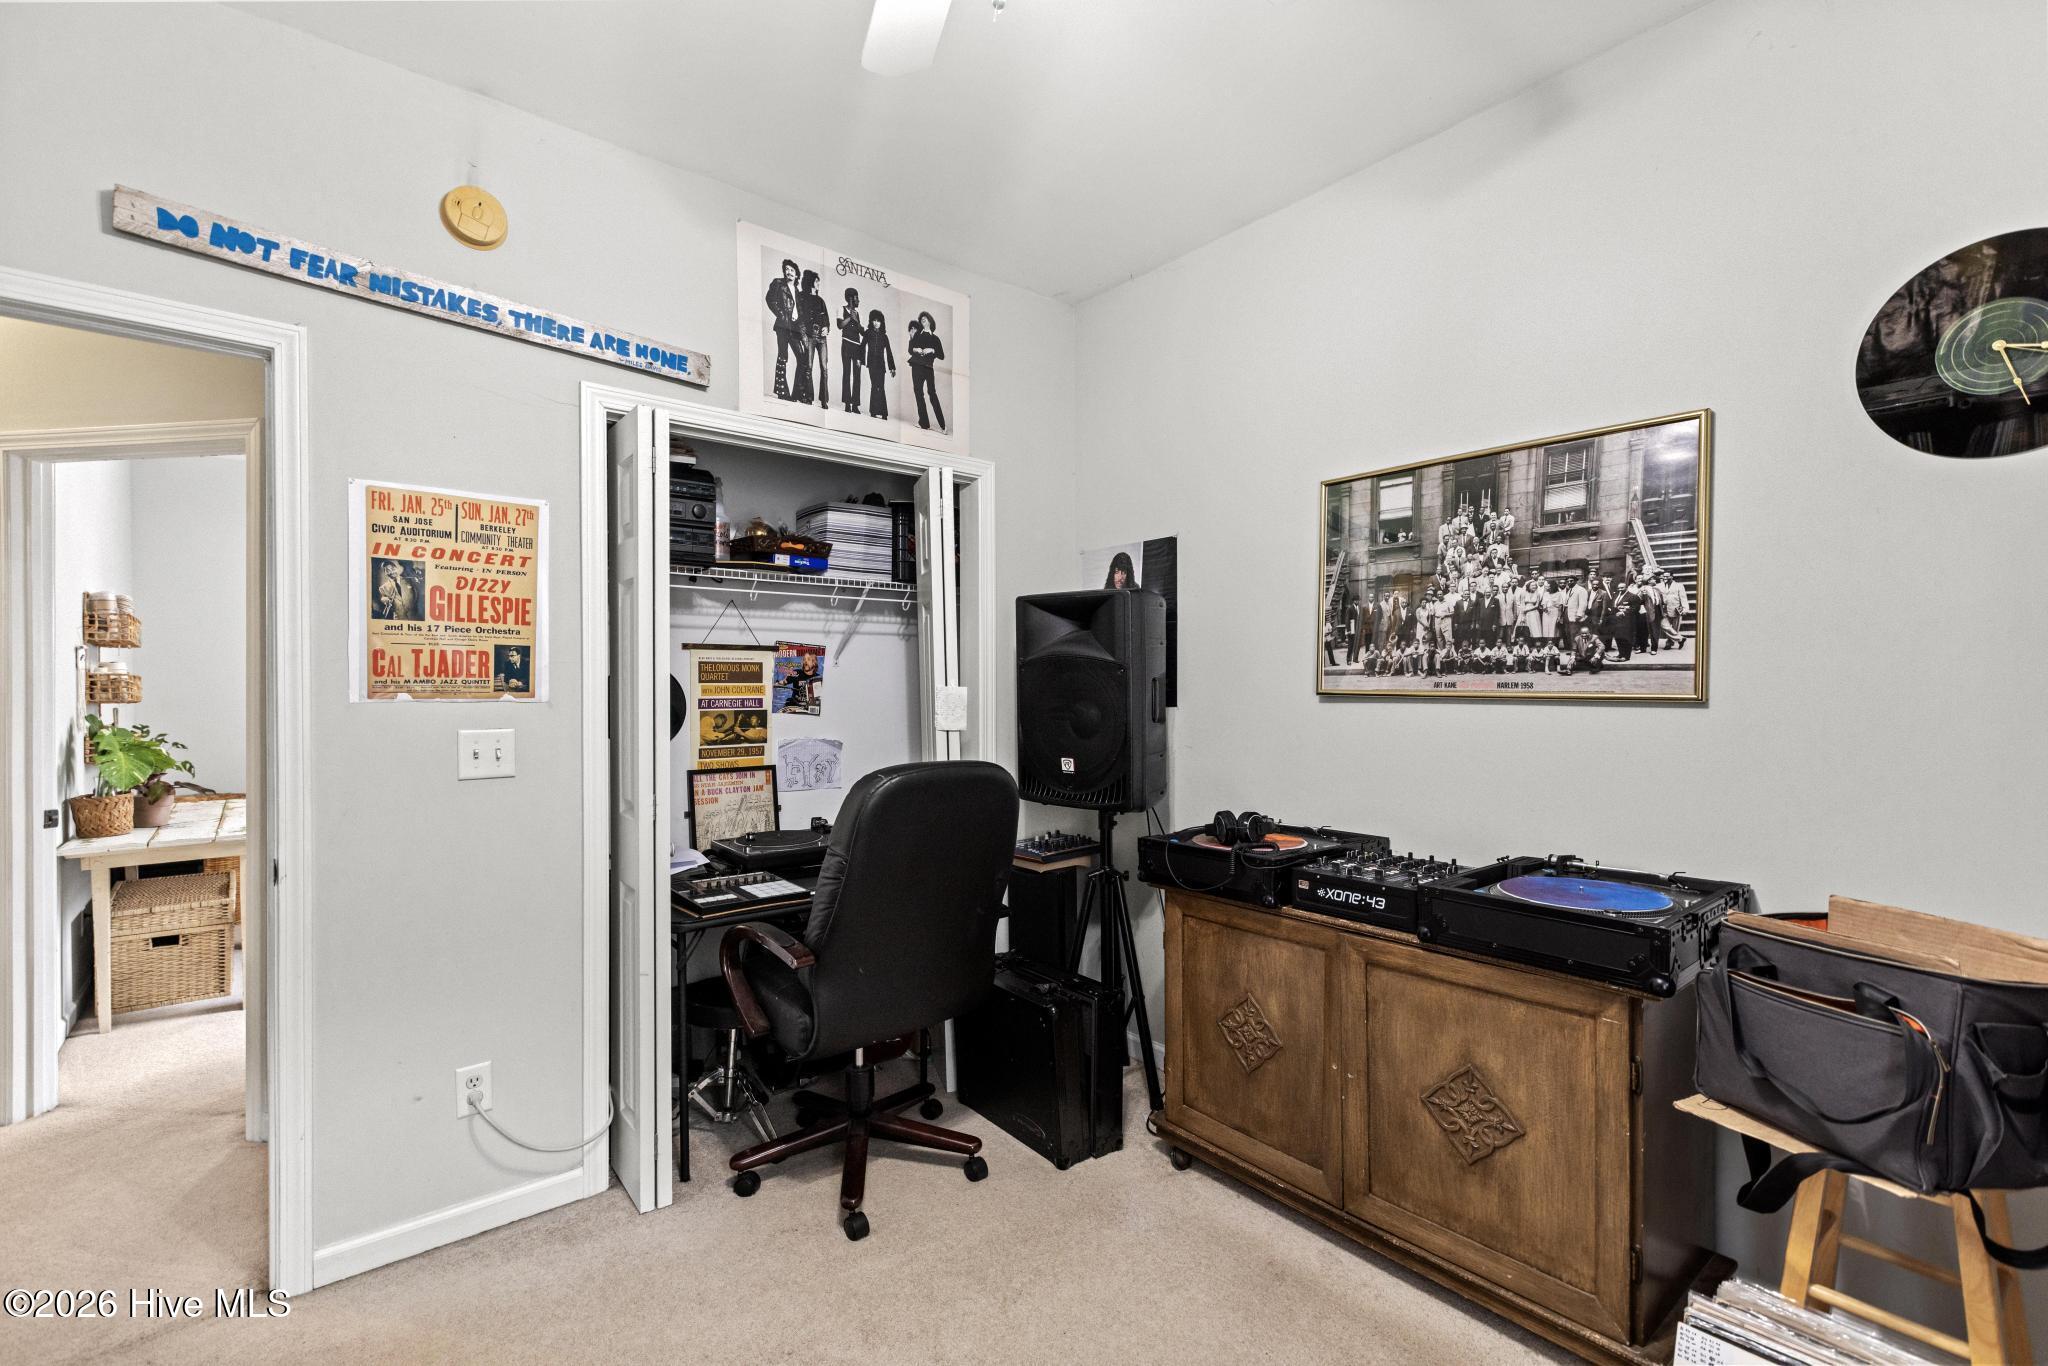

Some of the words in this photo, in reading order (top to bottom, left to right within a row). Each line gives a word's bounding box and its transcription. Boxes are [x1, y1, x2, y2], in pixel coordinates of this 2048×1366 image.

[836, 256, 891, 288] SANTANA
[156, 206, 199, 238] DO
[209, 221, 280, 262] NOT
[289, 247, 359, 287] FEAR
[508, 309, 585, 343] THERE
[589, 332, 630, 357] ARE
[371, 490, 395, 511] FRI.
[400, 493, 425, 515] JAN.
[431, 497, 453, 516] 25th
[461, 501, 484, 521] SUN.
[488, 504, 511, 525] JAN.
[515, 508, 534, 526] 27th
[392, 515, 410, 524] SAN
[414, 517, 433, 526] JOSE
[371, 523, 396, 534] CIVIC
[400, 526, 452, 539] AUDITORIUM
[480, 523, 516, 534] BERKELEY
[460, 530, 501, 546] COMMUNITY
[507, 535, 534, 549] THEATER
[371, 542, 400, 556] IN
[411, 545, 532, 568] CONCERT
[434, 563, 474, 573] Featuring
[455, 575, 511, 594] DIZZY
[429, 584, 532, 626] GILLESPIE
[407, 624, 422, 632] his
[444, 625, 471, 634] Piece
[475, 626, 521, 636] Orchestra
[411, 648, 490, 679] TJADER
[700, 663, 740, 672] THELONIOUS
[741, 664, 760, 672] MONK
[700, 672, 729, 681] QUARTET
[714, 686, 730, 694] JOHN
[731, 685, 764, 694] COLTRANE
[1496, 681, 1519, 689] HARLEM
[700, 700, 709, 708] AT
[710, 699, 743, 708] CARNEGIE
[744, 699, 760, 707] HALL
[702, 749, 736, 758] NOVEMBER
[749, 747, 763, 756] 1957
[707, 788, 723, 796] BUCK
[725, 785, 751, 795] CLAYTON
[753, 784, 764, 793] JAM
